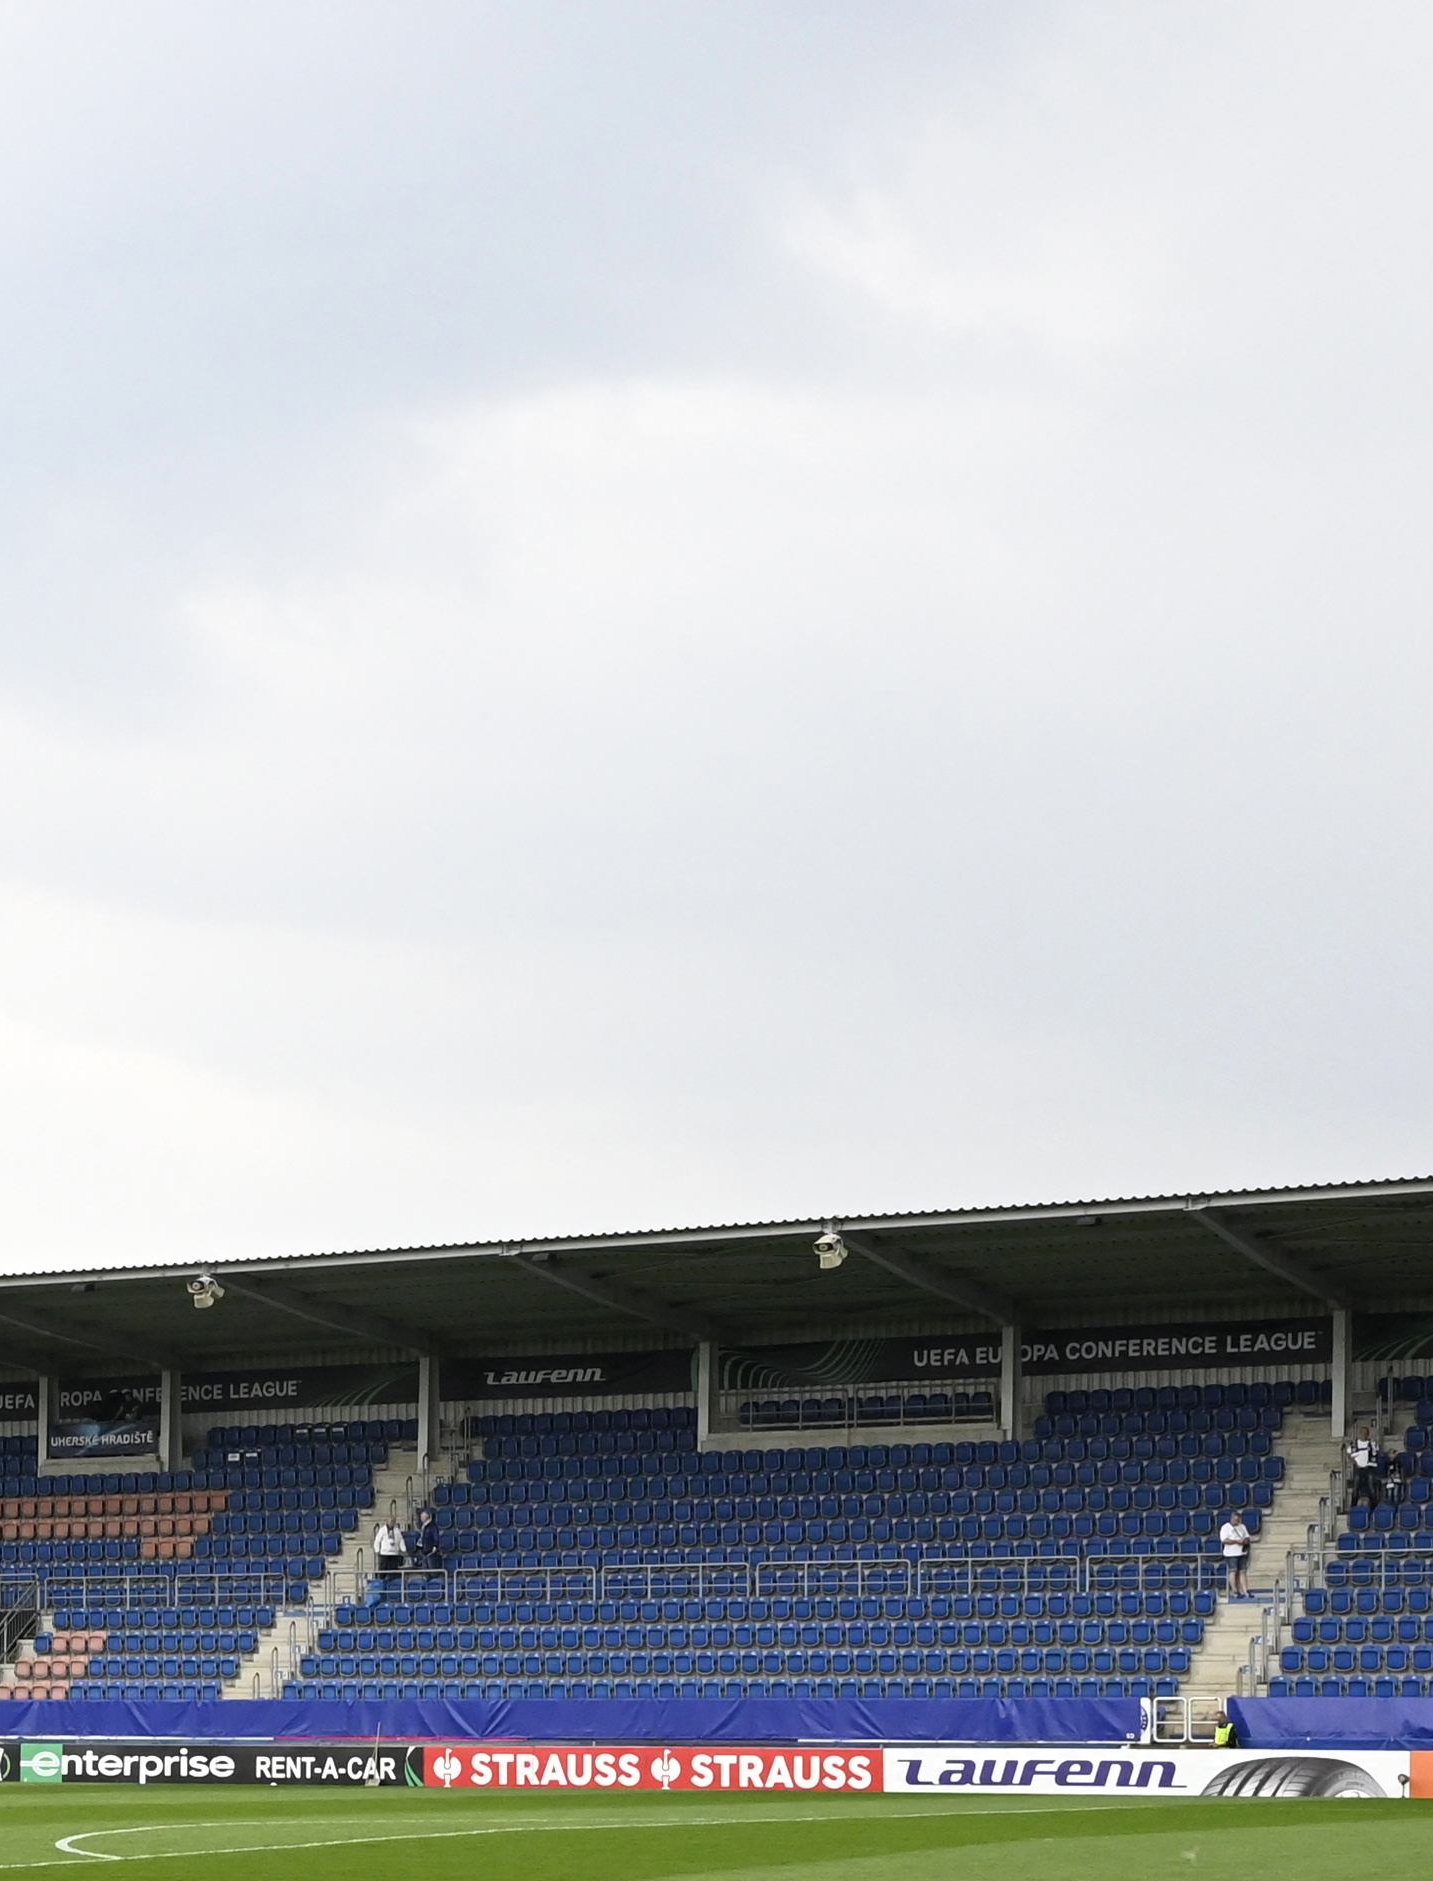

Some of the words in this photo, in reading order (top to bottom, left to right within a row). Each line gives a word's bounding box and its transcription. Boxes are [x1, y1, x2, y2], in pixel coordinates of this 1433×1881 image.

[913, 1348, 970, 1367] UEFA
[975, 1343, 1060, 1365] EUOPA
[1065, 1335, 1218, 1361] CONFERENCE
[1226, 1330, 1317, 1354] LEAGUE
[59, 1389, 103, 1408] ROPA
[229, 1379, 298, 1400] LEAGUE
[484, 1367, 607, 1386] Laufenn
[29, 1747, 235, 1784] enterprise
[254, 1756, 396, 1780] RENT-A-CAR
[469, 1752, 641, 1787] STRAUSS
[689, 1753, 872, 1790] STRAUSS
[896, 1758, 1187, 1789] Laufenn
